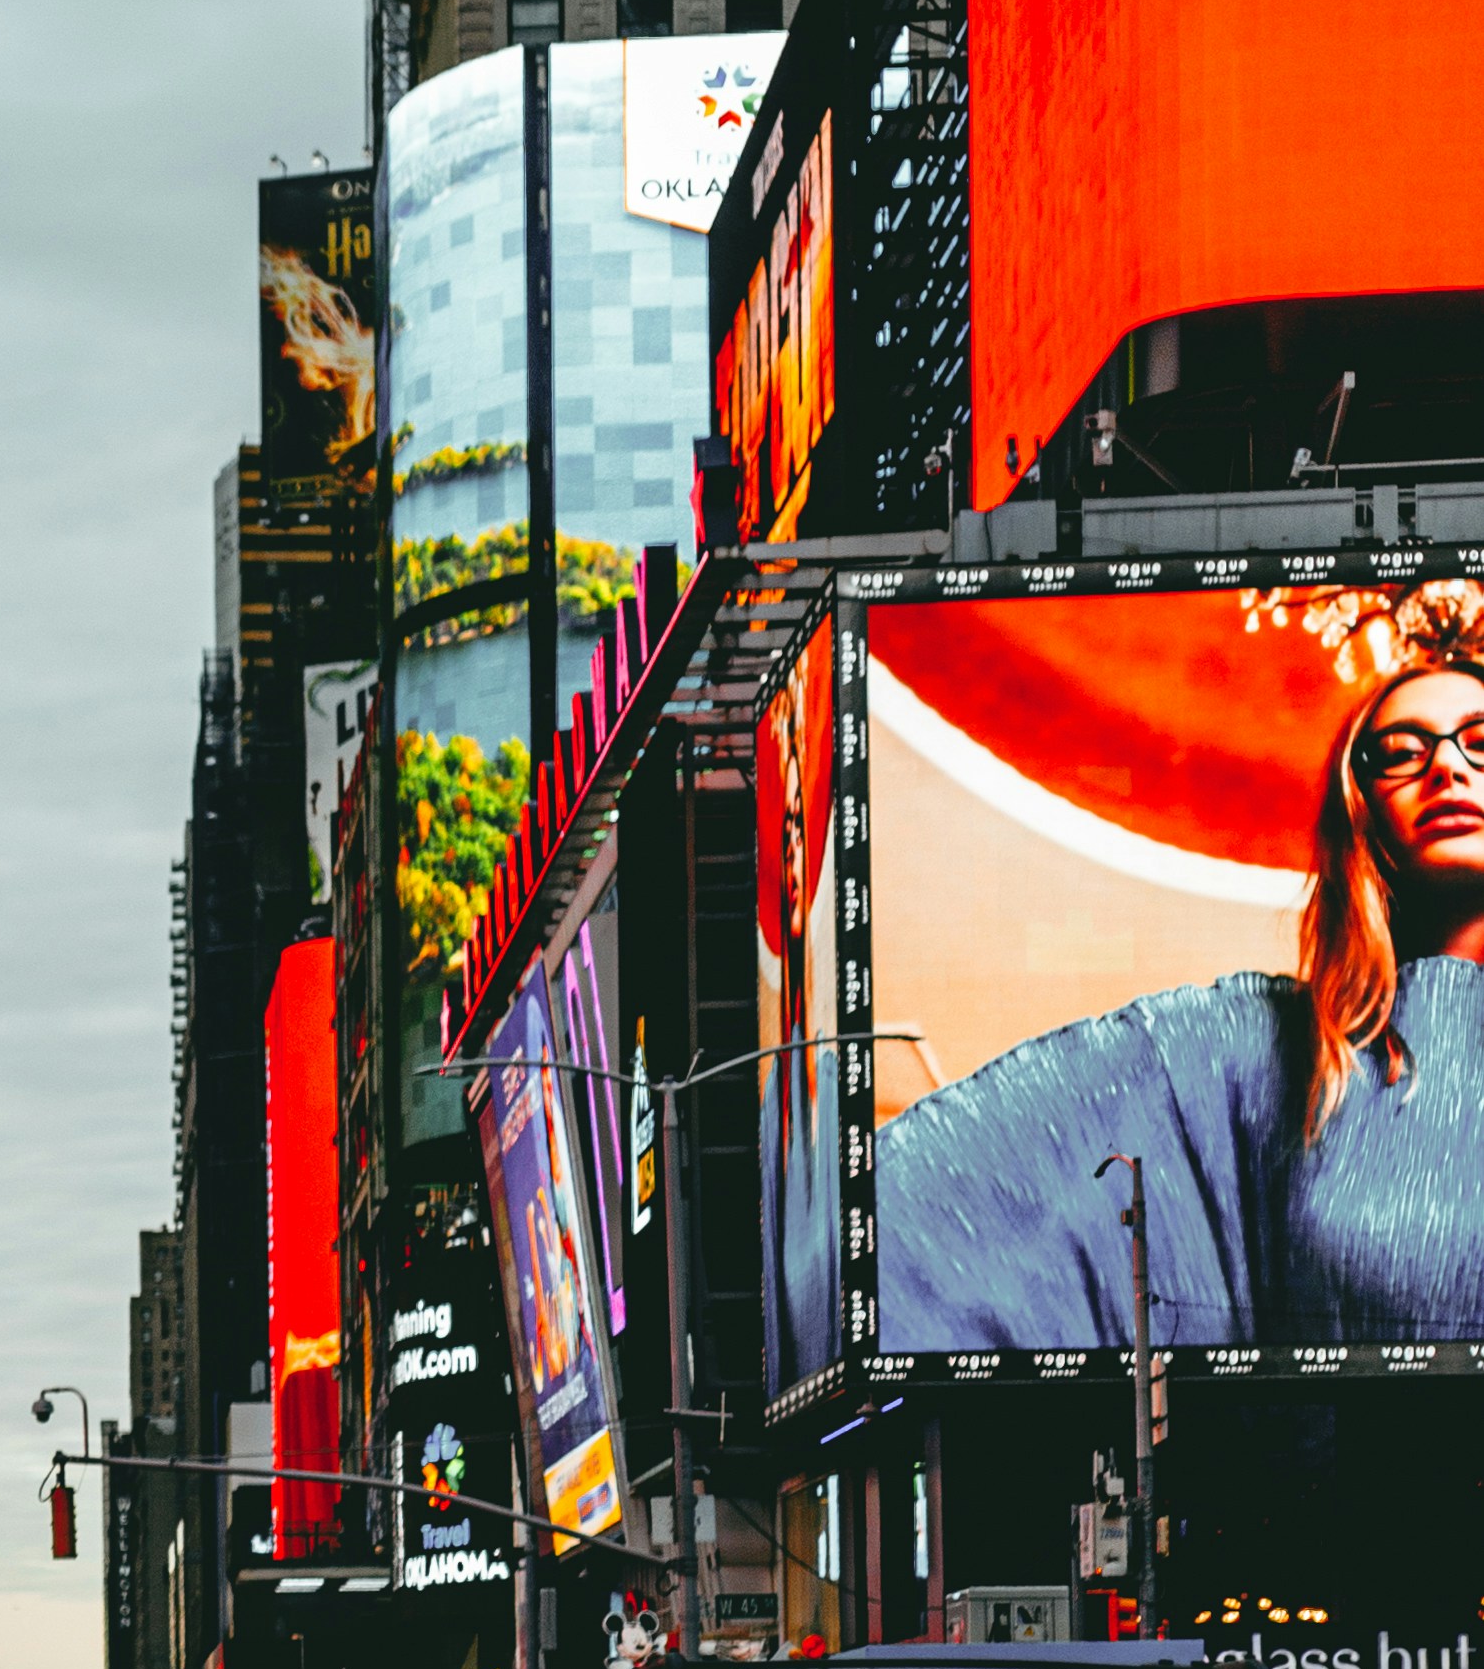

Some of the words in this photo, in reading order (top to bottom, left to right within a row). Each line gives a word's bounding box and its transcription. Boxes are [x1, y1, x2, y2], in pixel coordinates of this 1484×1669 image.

[695, 149, 741, 165] Tra
[641, 176, 733, 203] OKLA
[420, 1518, 472, 1550] Travel
[404, 1549, 509, 1591] OKLAHOMA
